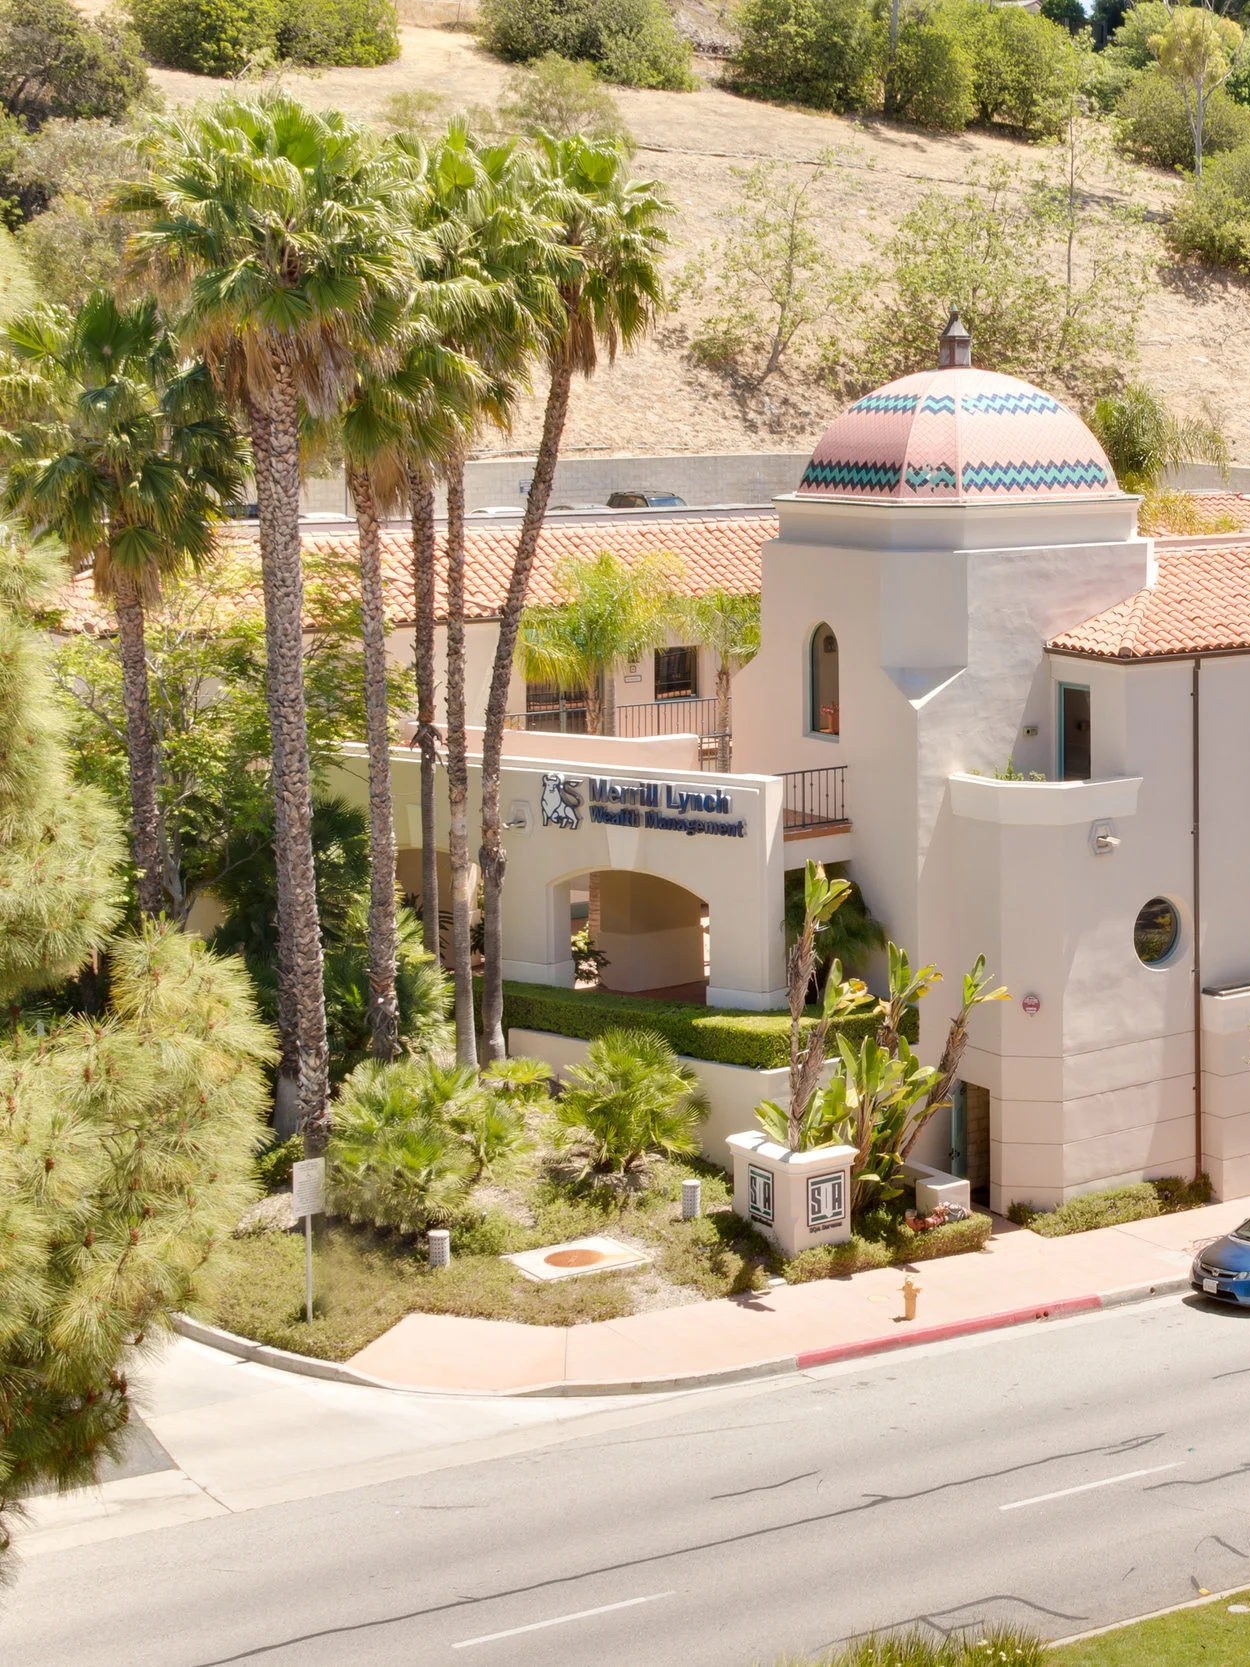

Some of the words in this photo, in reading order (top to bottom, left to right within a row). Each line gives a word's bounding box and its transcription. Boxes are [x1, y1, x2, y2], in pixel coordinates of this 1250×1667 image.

[588, 777, 660, 808] Merrill
[666, 784, 731, 814] Lynch
[589, 805, 642, 828] Wealth
[644, 810, 746, 838] Management
